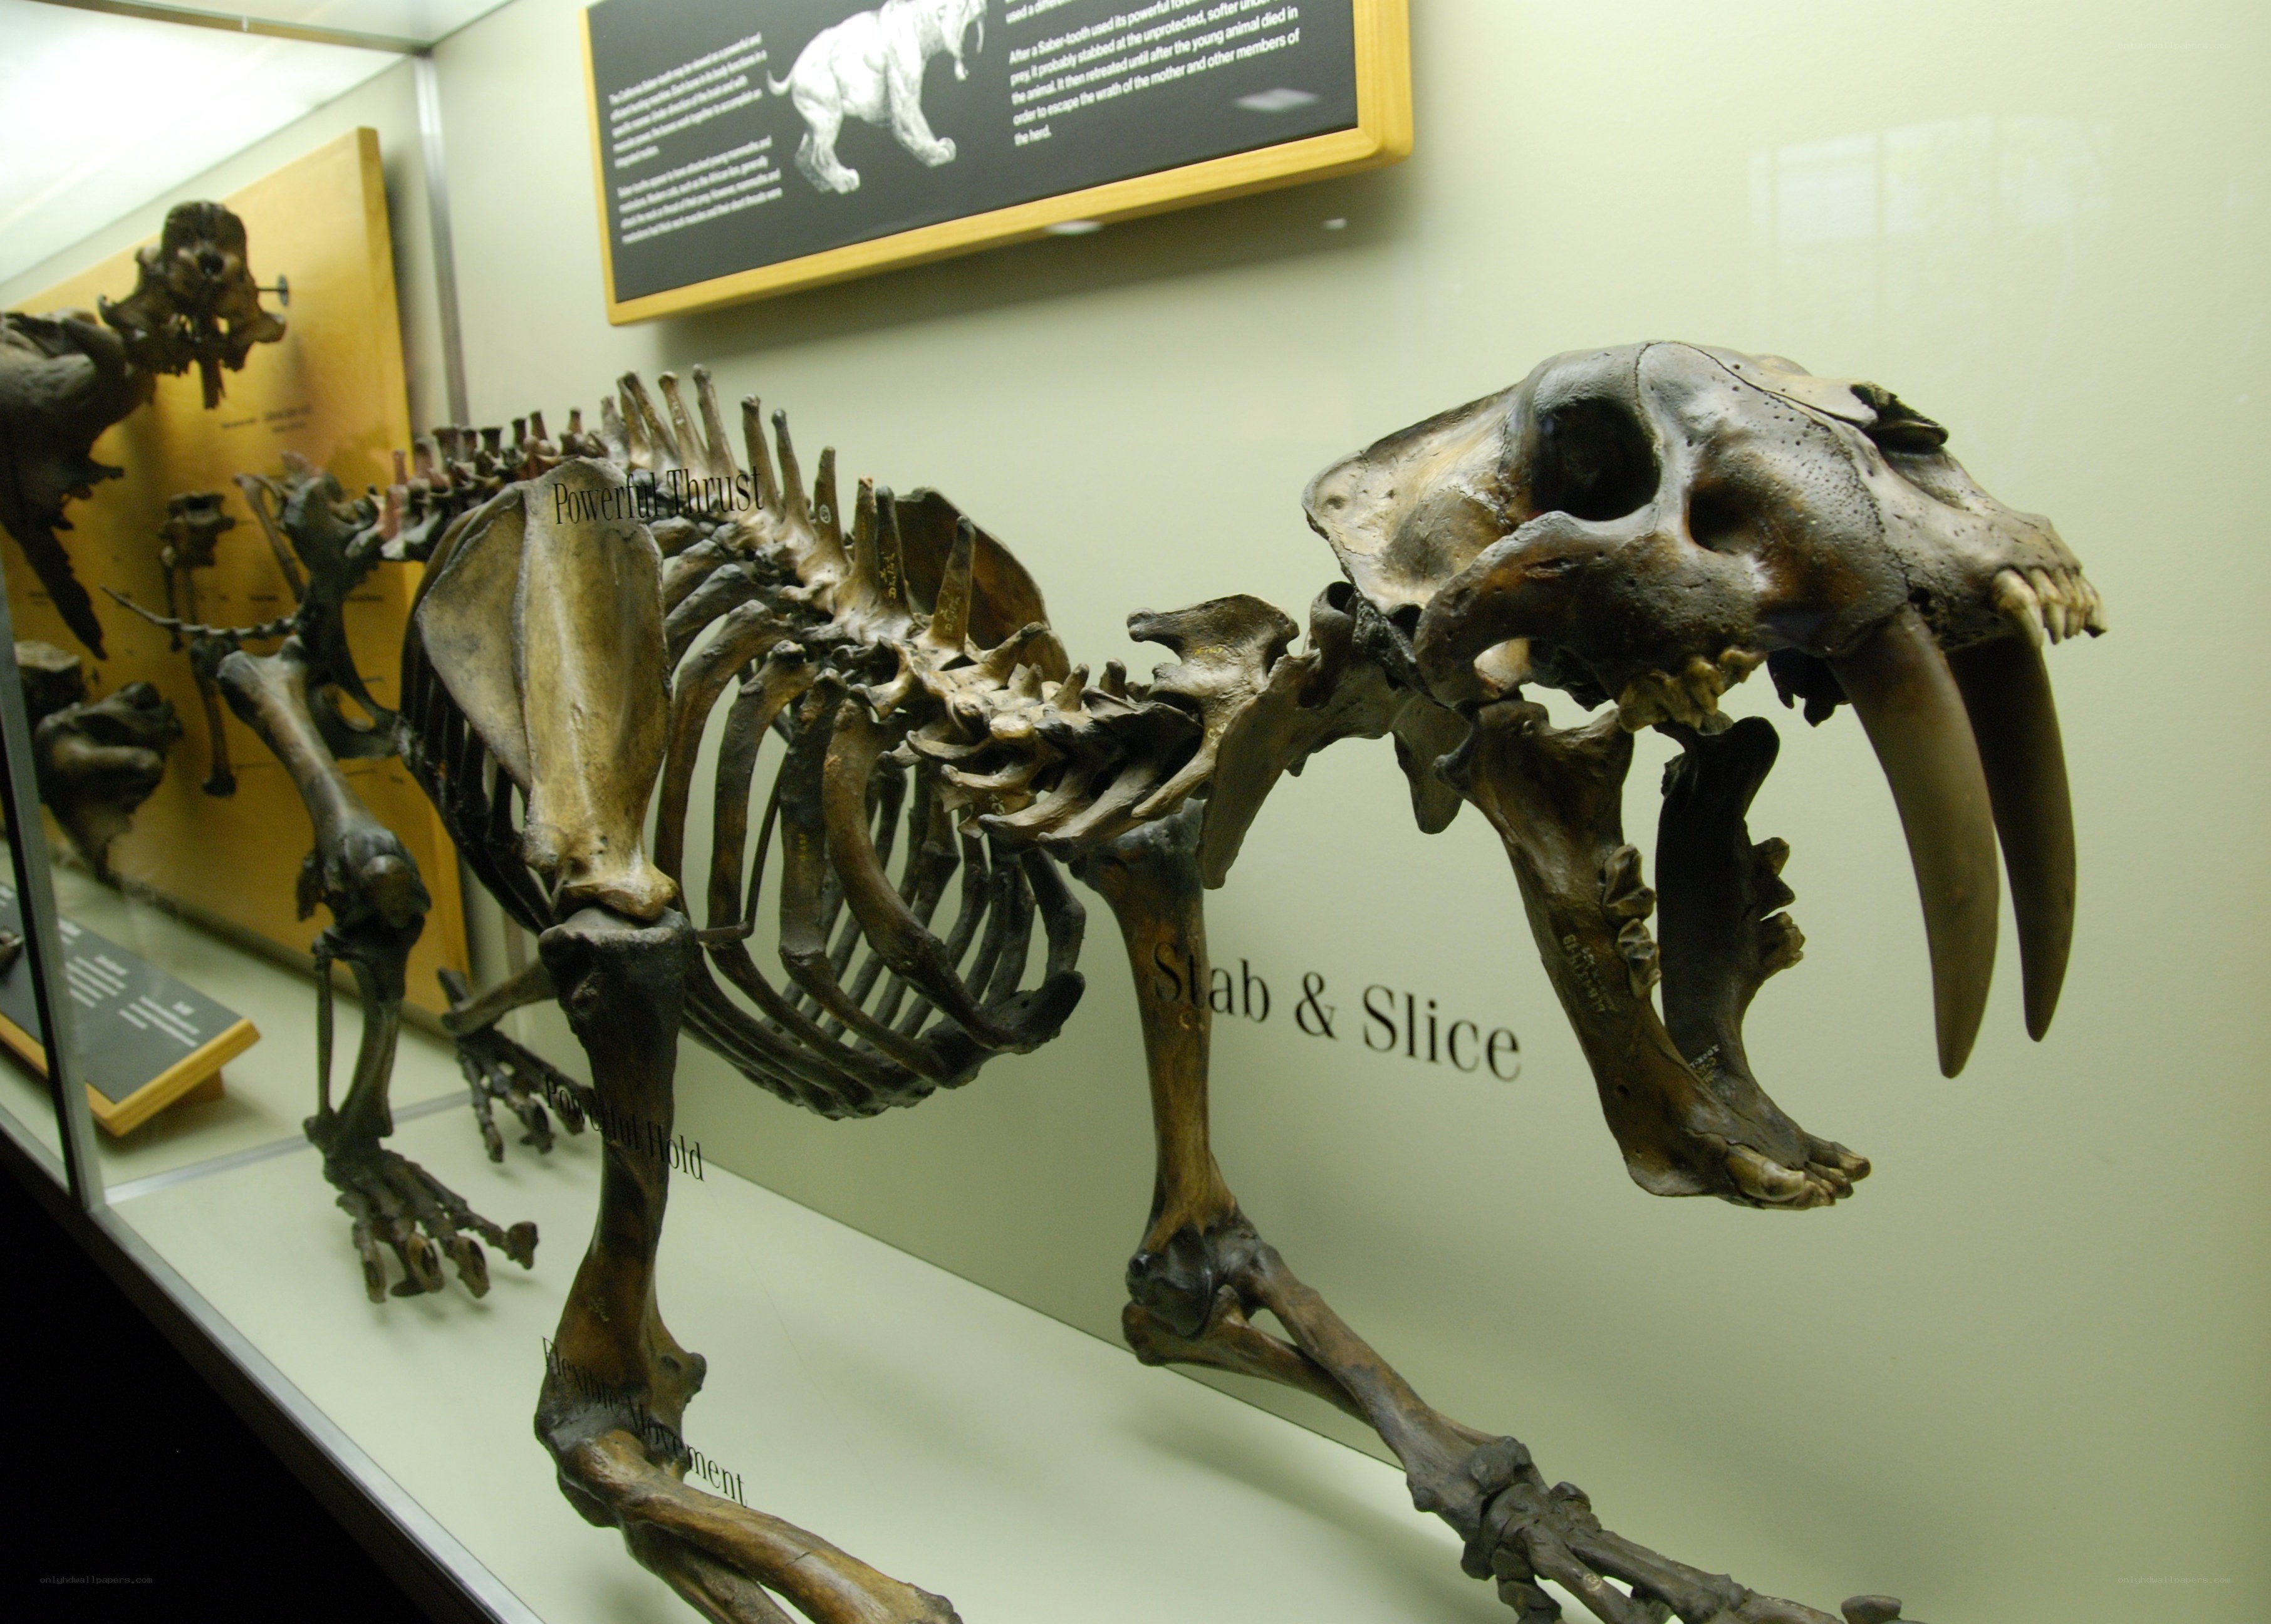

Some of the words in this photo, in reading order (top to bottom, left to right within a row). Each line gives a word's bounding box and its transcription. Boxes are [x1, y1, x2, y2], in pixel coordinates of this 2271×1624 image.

[1006, 4, 1027, 24] used
[1027, 5, 1034, 17] a
[1009, 47, 1031, 65] After
[1031, 46, 1038, 58] a
[1037, 26, 1091, 55] Saber-tooth
[1091, 16, 1114, 37] used
[1114, 15, 1127, 29] its
[1127, 0, 1170, 28] powerful
[1031, 65, 1038, 79] it
[1037, 53, 1077, 78] probably
[1077, 38, 1116, 63] stabbed
[1116, 36, 1126, 51] at
[1126, 32, 1143, 48] the
[1143, 9, 1207, 41] unprotected,
[1207, 2, 1239, 22] softer
[1011, 91, 1026, 106] the
[1057, 78, 1064, 91] It
[1065, 75, 1085, 90] then
[1085, 57, 1128, 82] retreated
[1128, 50, 1150, 70] until
[1150, 46, 1173, 63] after
[1173, 39, 1191, 55] the
[1192, 29, 1224, 53] young
[1225, 16, 1260, 39] animal
[1260, 8, 1286, 29] died
[1286, 6, 1299, 20] in
[1012, 109, 1036, 127] order
[1036, 106, 1047, 119] to
[1047, 96, 1079, 117] escape
[1079, 91, 1095, 107] the
[1095, 81, 1122, 102] wrath
[1122, 77, 1133, 94] of
[1133, 75, 1150, 90] the
[1150, 64, 1185, 85] mother
[1186, 55, 1207, 75] and
[1207, 49, 1235, 69] other
[1235, 34, 1287, 60] members
[1287, 27, 1300, 45] of
[1014, 132, 1029, 147] the
[553, 472, 658, 524] Powerful
[667, 466, 764, 515] Thrust
[1153, 942, 1271, 1024] Stab
[1295, 971, 1339, 1041] &
[1362, 984, 1522, 1083] Slice
[647, 1120, 705, 1182] Hold
